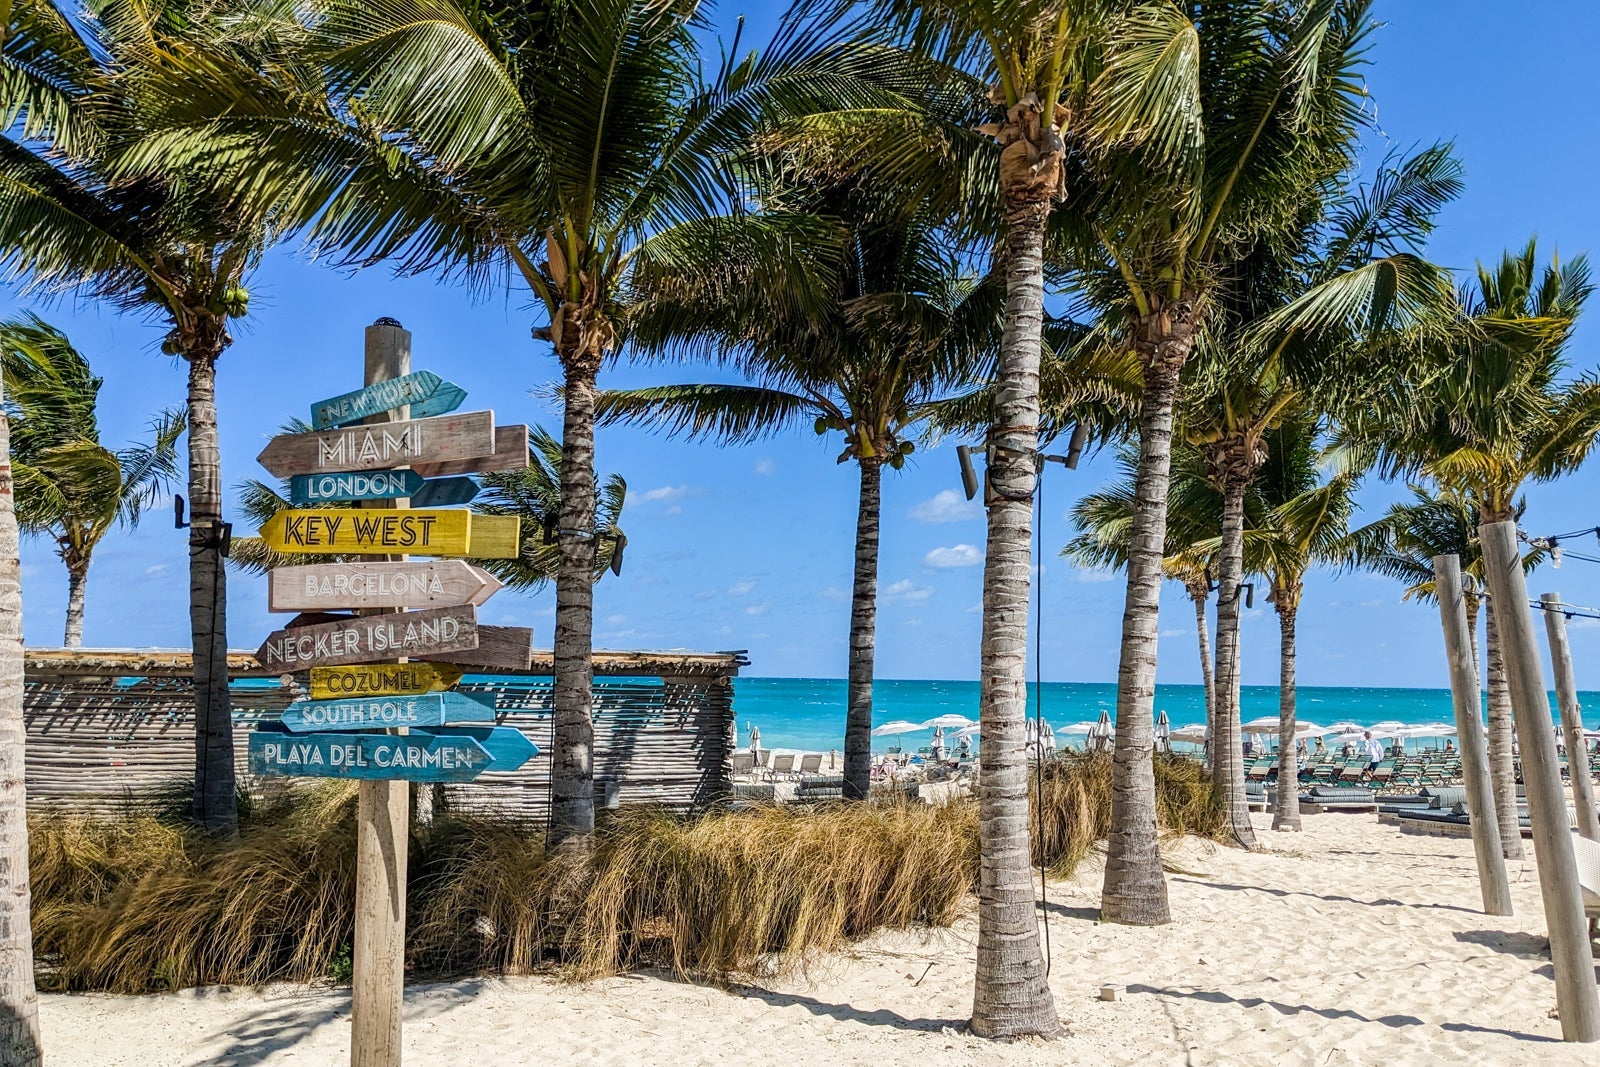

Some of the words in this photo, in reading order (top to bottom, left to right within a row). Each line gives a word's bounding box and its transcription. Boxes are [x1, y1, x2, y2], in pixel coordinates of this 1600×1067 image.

[326, 394, 366, 420] NEW
[371, 378, 424, 405] YORK
[318, 424, 421, 468] MIAMI
[308, 472, 406, 499] LONDON
[284, 516, 344, 546] KEY
[353, 516, 437, 546] WEST
[305, 573, 445, 597] BARCELONA
[266, 629, 360, 664] NECKER
[367, 616, 459, 652] ISLAND
[327, 671, 422, 693] COZUMEL
[302, 705, 364, 726] SOUTH
[369, 701, 418, 723] POLE
[264, 743, 324, 766] PLAYA
[330, 745, 368, 767] DEL
[374, 746, 473, 769] CARMEN
